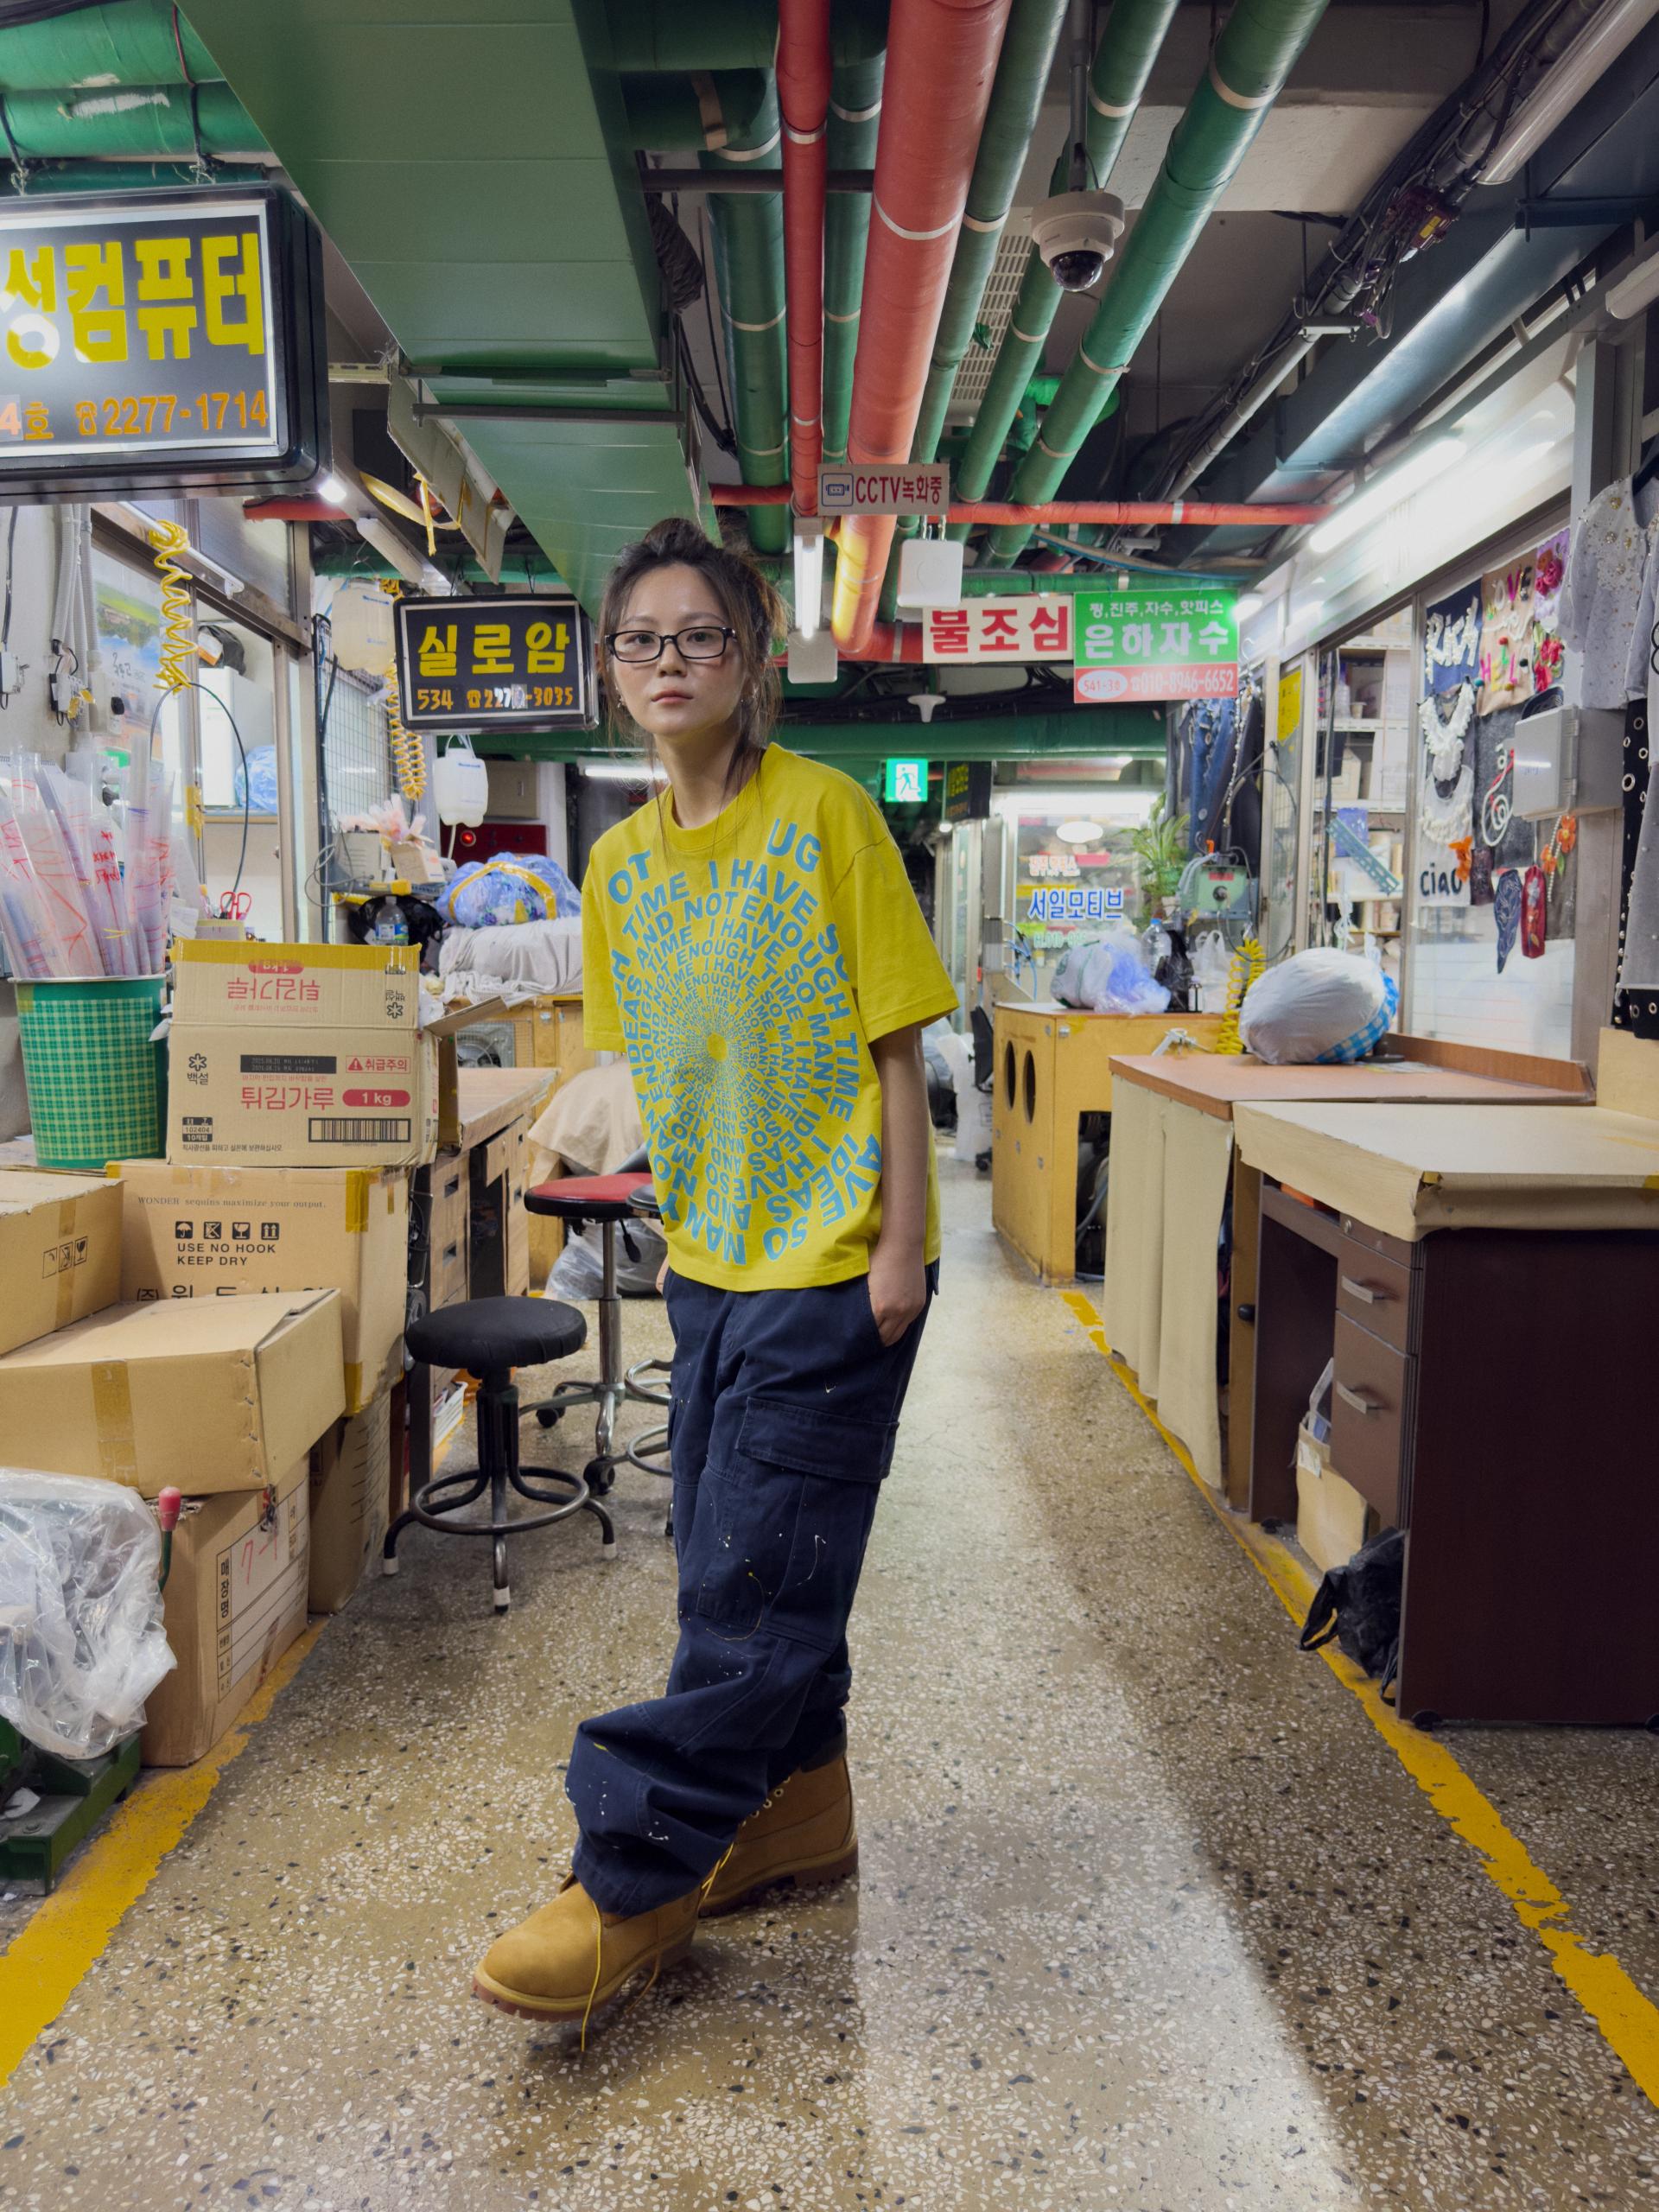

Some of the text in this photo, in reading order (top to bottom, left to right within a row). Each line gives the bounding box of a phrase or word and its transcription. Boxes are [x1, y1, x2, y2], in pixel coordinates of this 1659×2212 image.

[418, 621, 570, 677] 실로암
[930, 606, 1068, 654] 불조심
[1084, 620, 1229, 658] 은하자수
[417, 689, 454, 710] 534
[709, 861, 719, 889] I
[730, 859, 818, 926] HAVE
[622, 872, 690, 941] TIME
[684, 891, 739, 923] NOT
[1028, 890, 1122, 919] 서일모티브
[636, 911, 674, 969] AND
[676, 939, 757, 968] ENOUGH
[741, 894, 850, 1020] ENOUGH
[227, 977, 321, 1001] 튀김가루
[650, 961, 671, 1006] NOT
[761, 958, 804, 1023] TIME
[623, 975, 645, 1077] IDEAS
[365, 1058, 408, 1071] 취급주의
[638, 918, 834, 1177] I HAVE SO MANY IDEAS AND NOT ENOUGH TIME
[187, 1072, 208, 1085] 백설
[779, 1058, 812, 1121] HAVE
[828, 1033, 860, 1122] TIME
[240, 1087, 334, 1110] 튀김가루
[361, 1092, 392, 1107] 1 kg
[751, 1115, 782, 1147] SO
[811, 1135, 831, 1154] I
[705, 1162, 729, 1197] SO
[733, 1143, 815, 1205] HAVE
[766, 1134, 859, 1231] IDEAS
[820, 1134, 883, 1227] AVE
[137, 1197, 180, 1205] WONDER
[185, 1198, 220, 1207] sequins
[223, 1198, 268, 1207] maximize
[270, 1200, 290, 1209] your
[703, 1189, 751, 1230] AND
[177, 1243, 276, 1254] USE NO HOOK
[763, 1209, 808, 1261] SO
[177, 1255, 248, 1266] KEEP DRY
